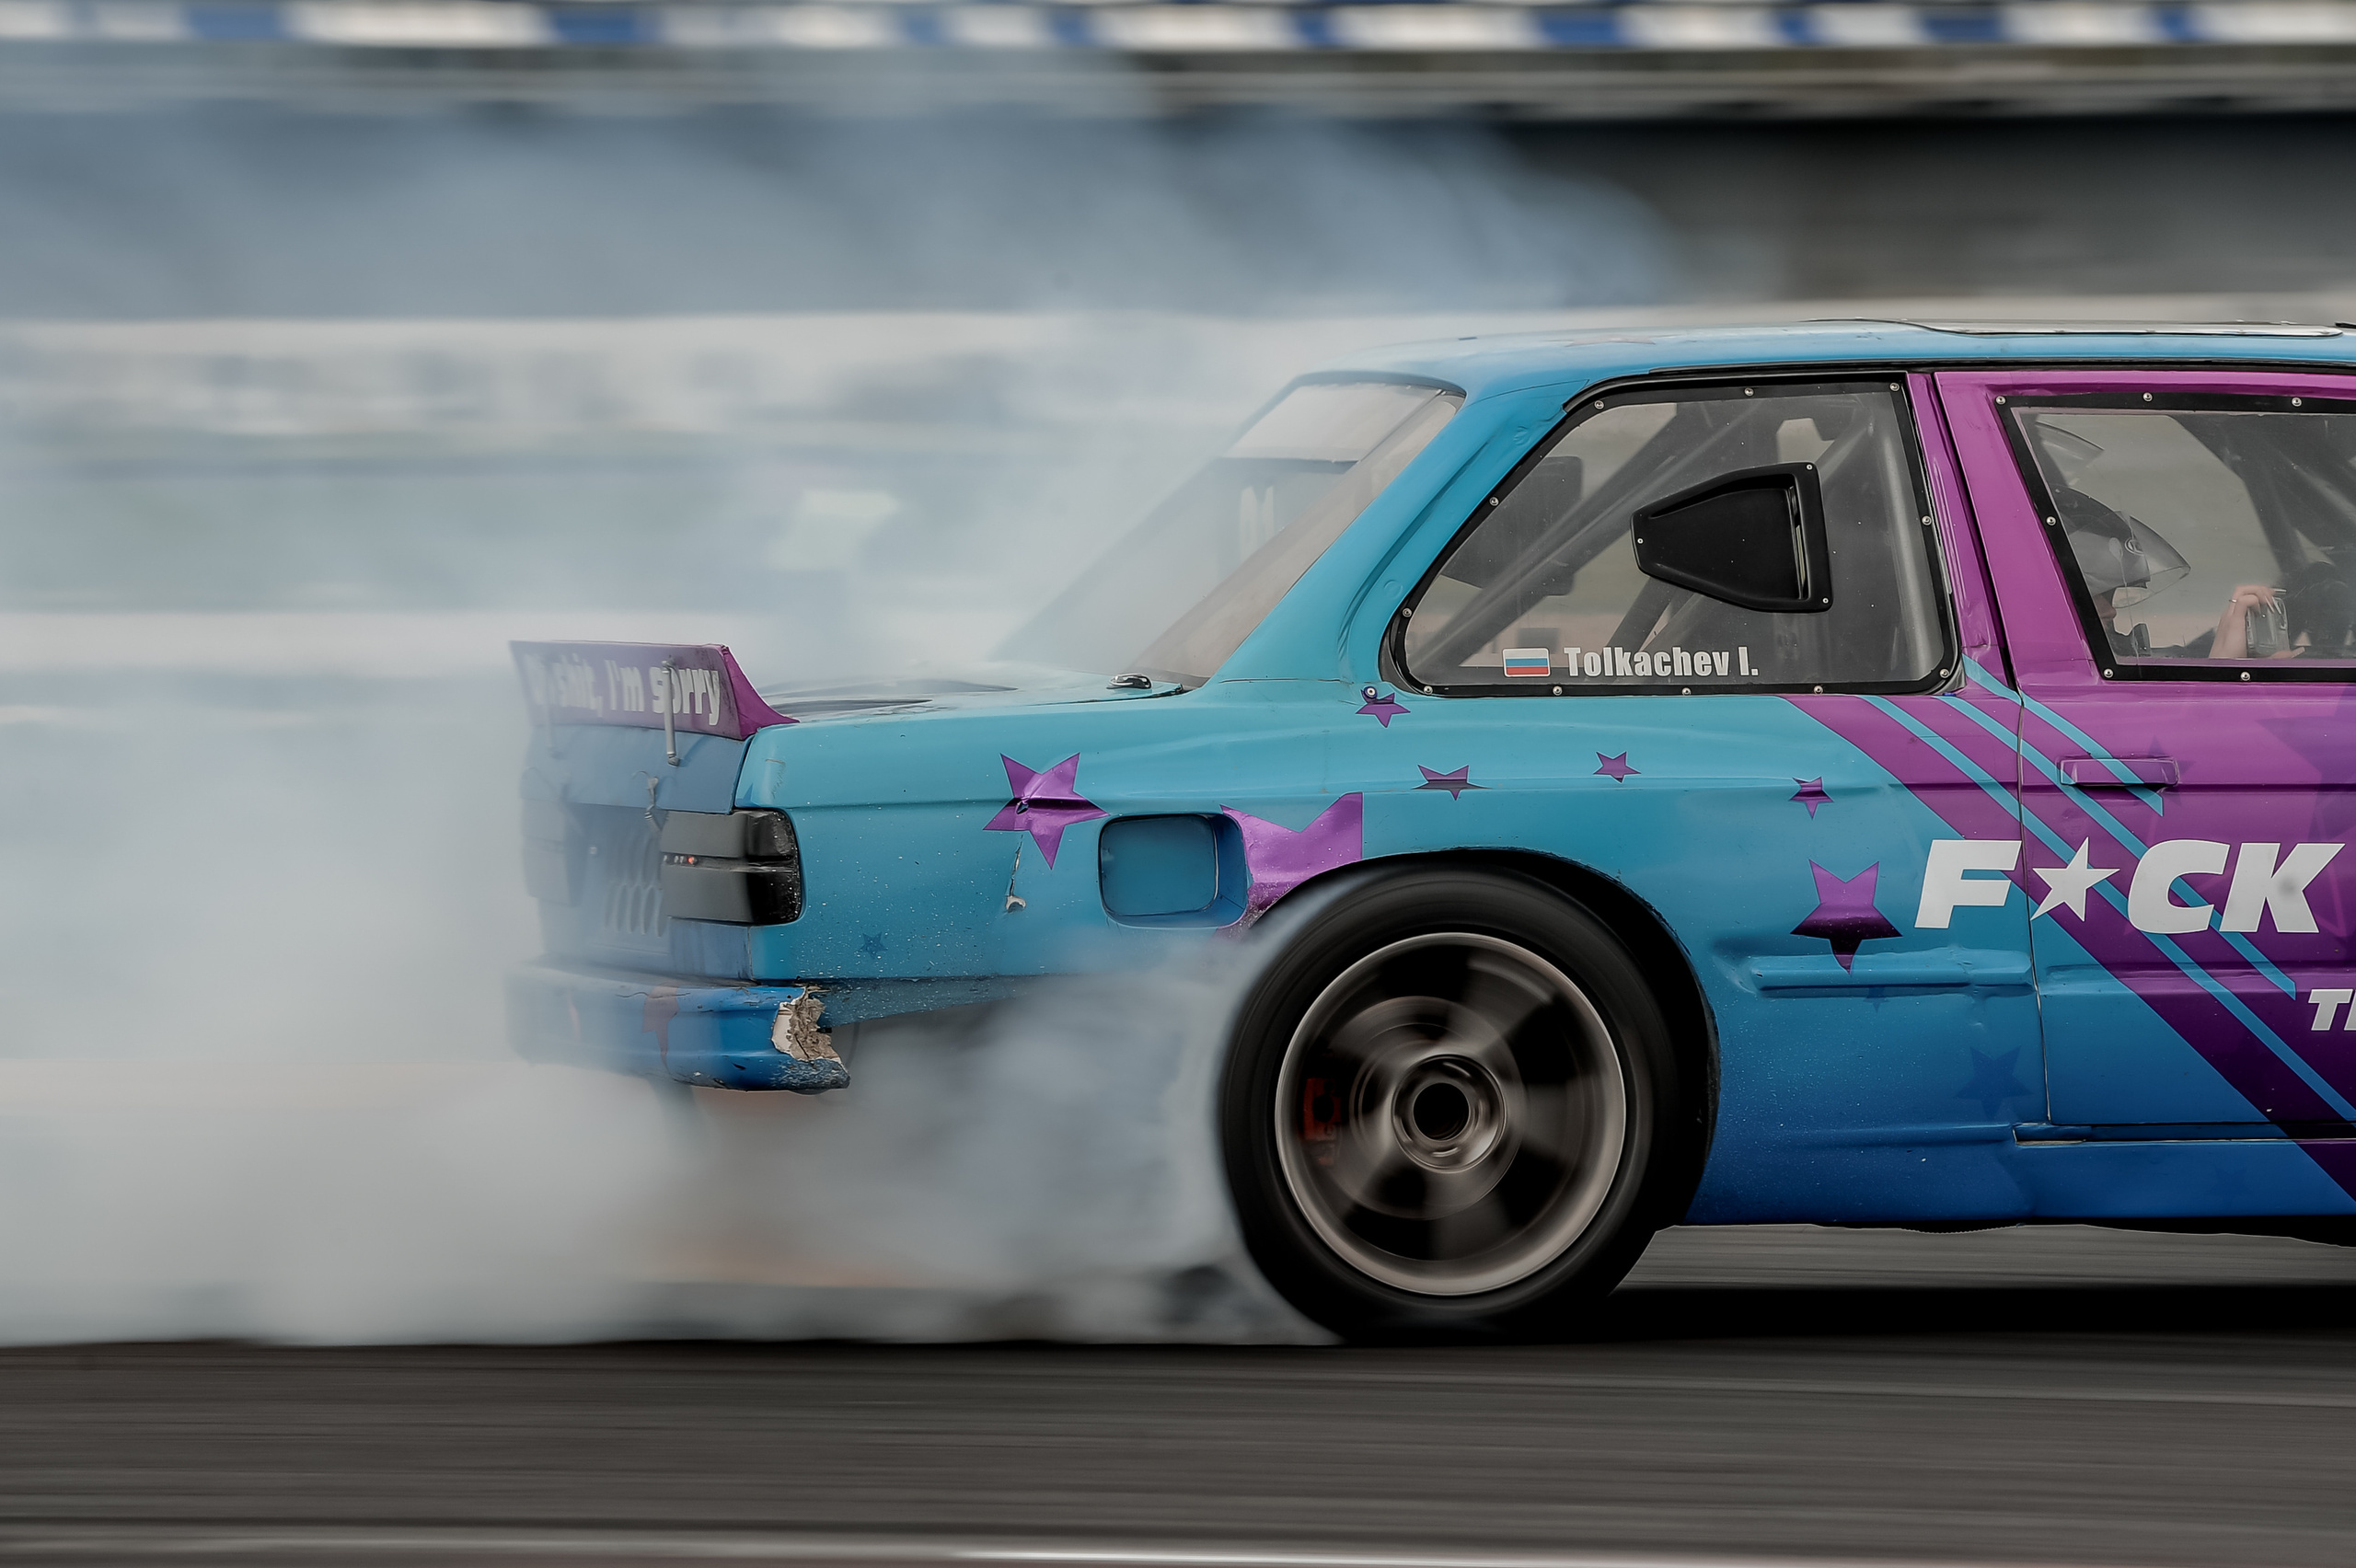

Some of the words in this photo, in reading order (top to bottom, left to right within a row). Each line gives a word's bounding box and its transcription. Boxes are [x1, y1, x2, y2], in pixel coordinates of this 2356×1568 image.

[1565, 646, 1730, 676] Tolkachev
[1738, 646, 1760, 676] I.
[605, 659, 644, 712] I'm
[2308, 988, 2356, 1031] T
